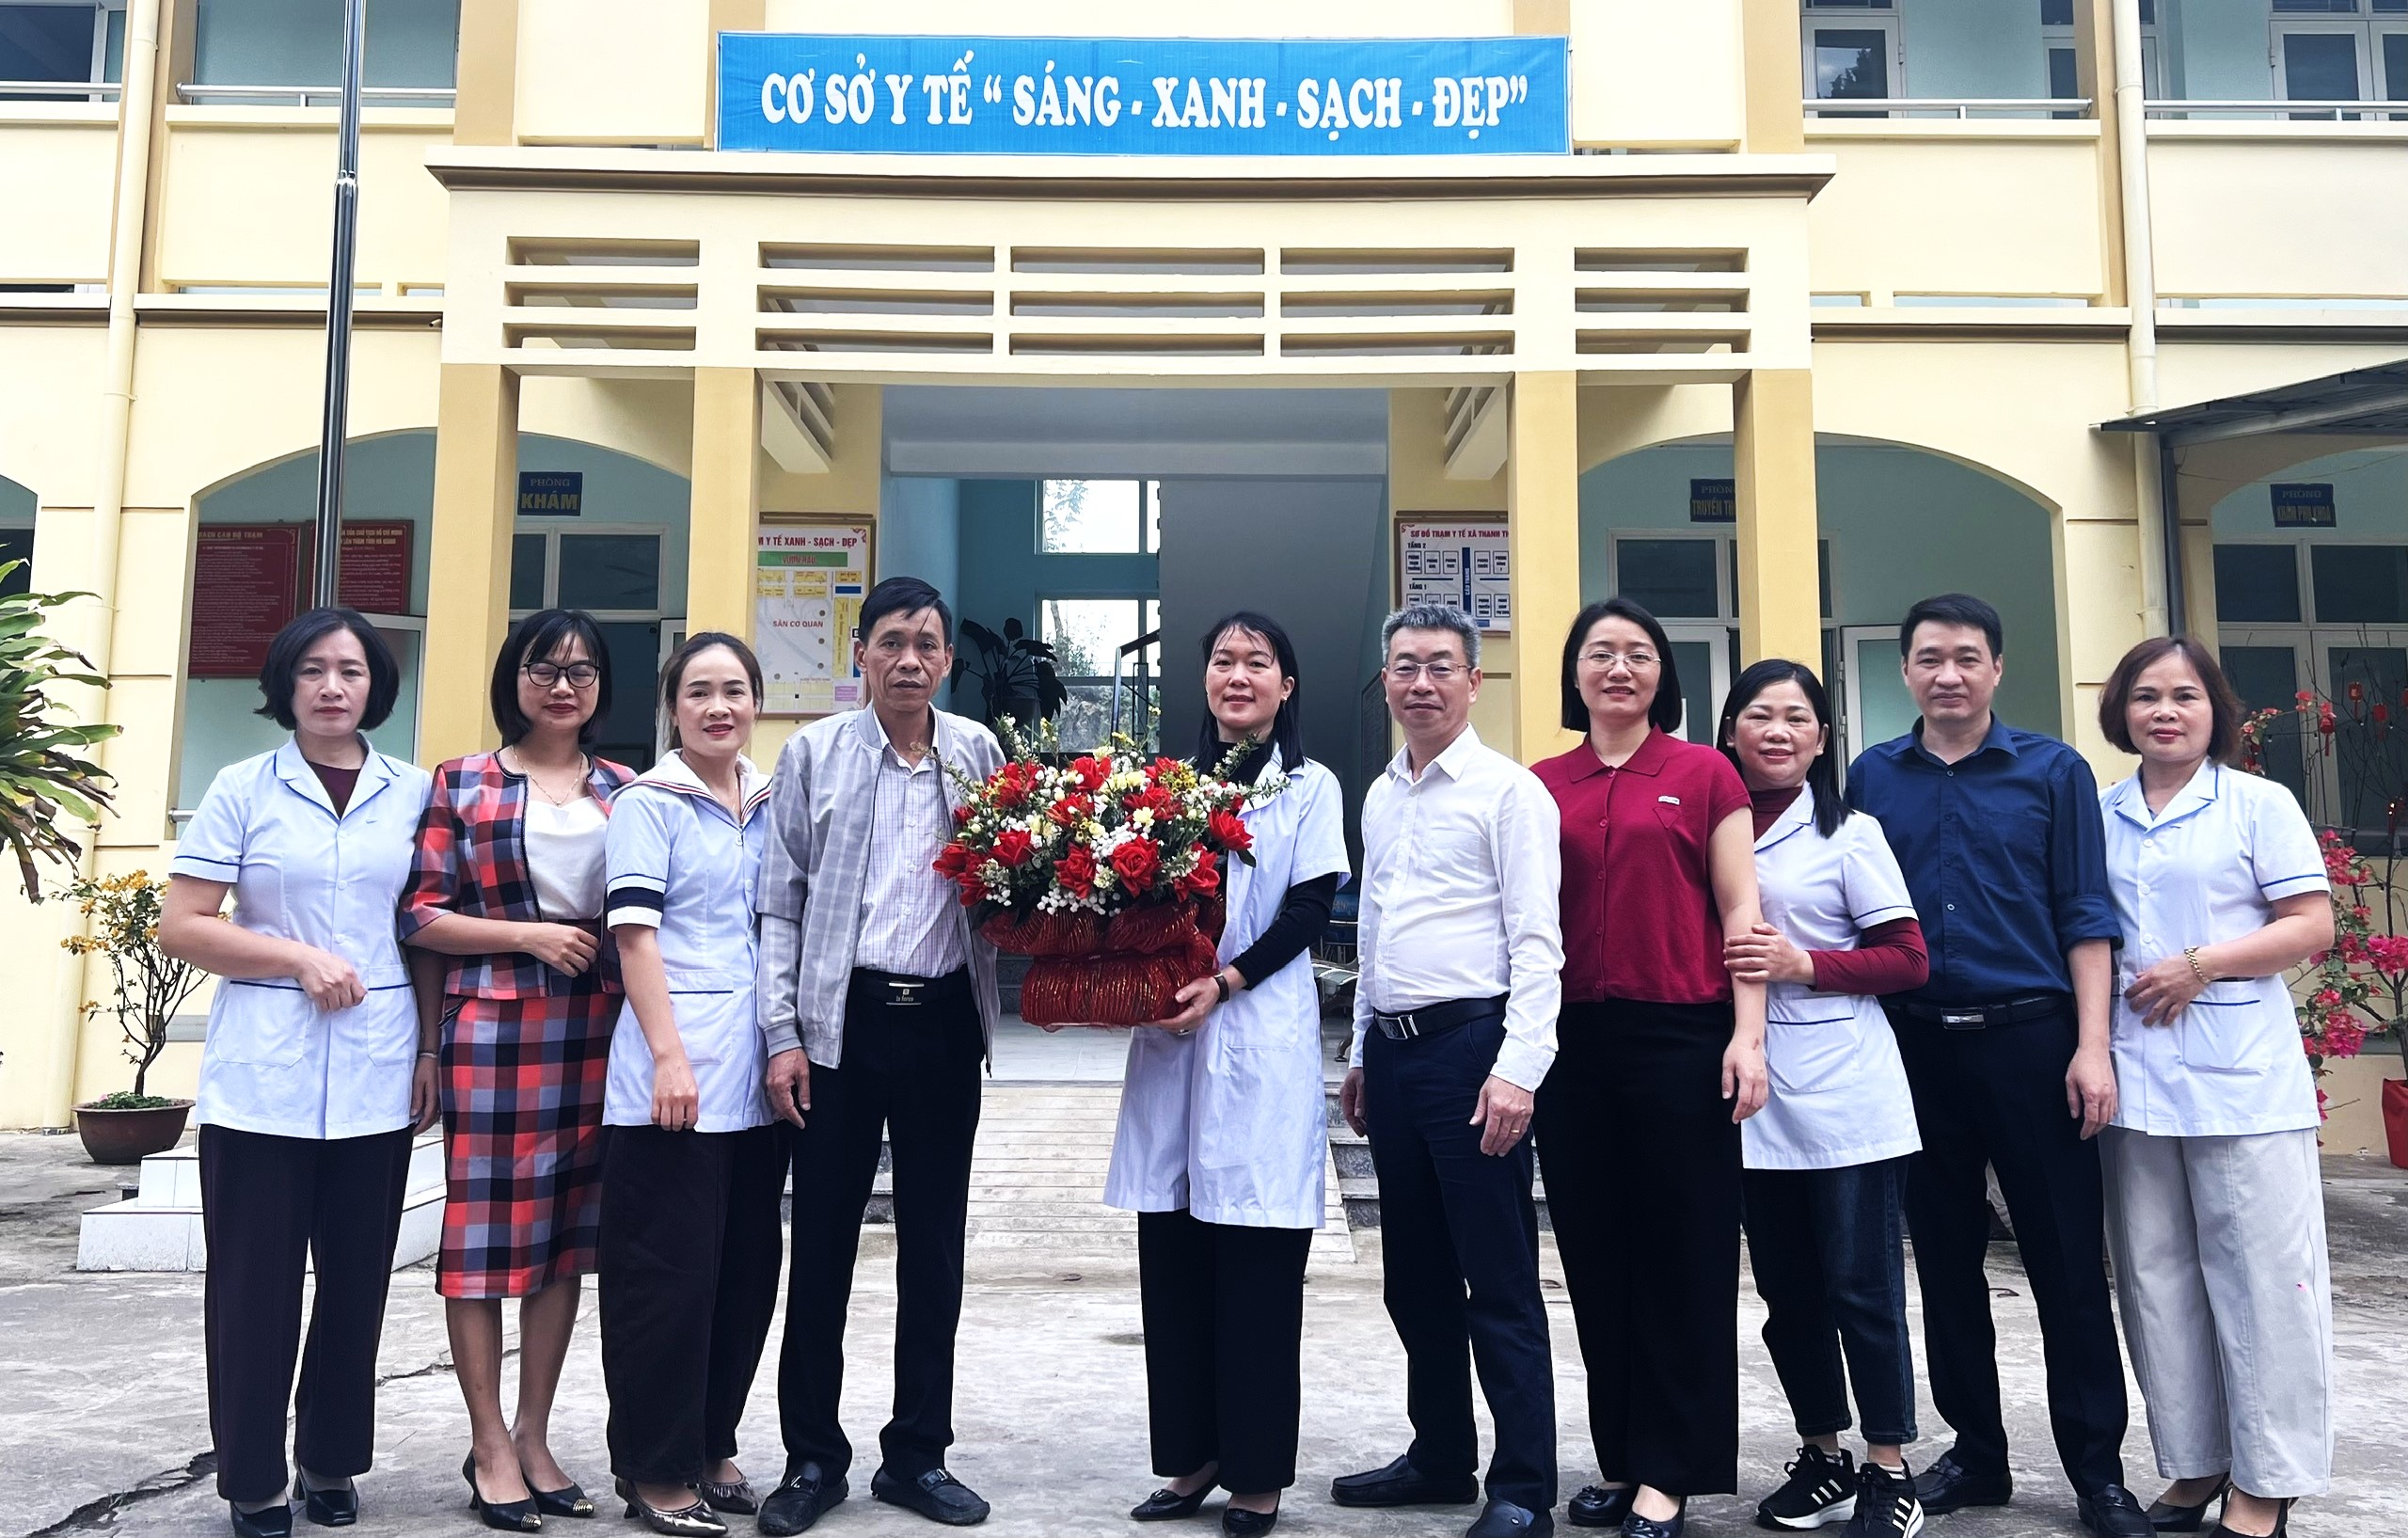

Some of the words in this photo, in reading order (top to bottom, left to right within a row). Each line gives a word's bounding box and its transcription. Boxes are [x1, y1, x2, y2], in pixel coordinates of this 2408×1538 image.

[762, 69, 815, 123] CƠ
[825, 54, 876, 124] SỞ
[885, 74, 912, 124] Y
[923, 51, 974, 124] TẾ
[1013, 60, 1121, 126] SÁNG
[1152, 77, 1266, 128] XANH
[1298, 78, 1402, 140] SẠCH
[530, 477, 570, 486] PHÒNG
[1701, 484, 1733, 494] PHÒN
[2282, 488, 2322, 499] PHÒNG
[521, 490, 578, 510] KHÁM
[767, 537, 771, 546] Y
[773, 534, 783, 546] TẾ
[784, 537, 806, 547] XANH
[814, 537, 834, 548] SẠCH
